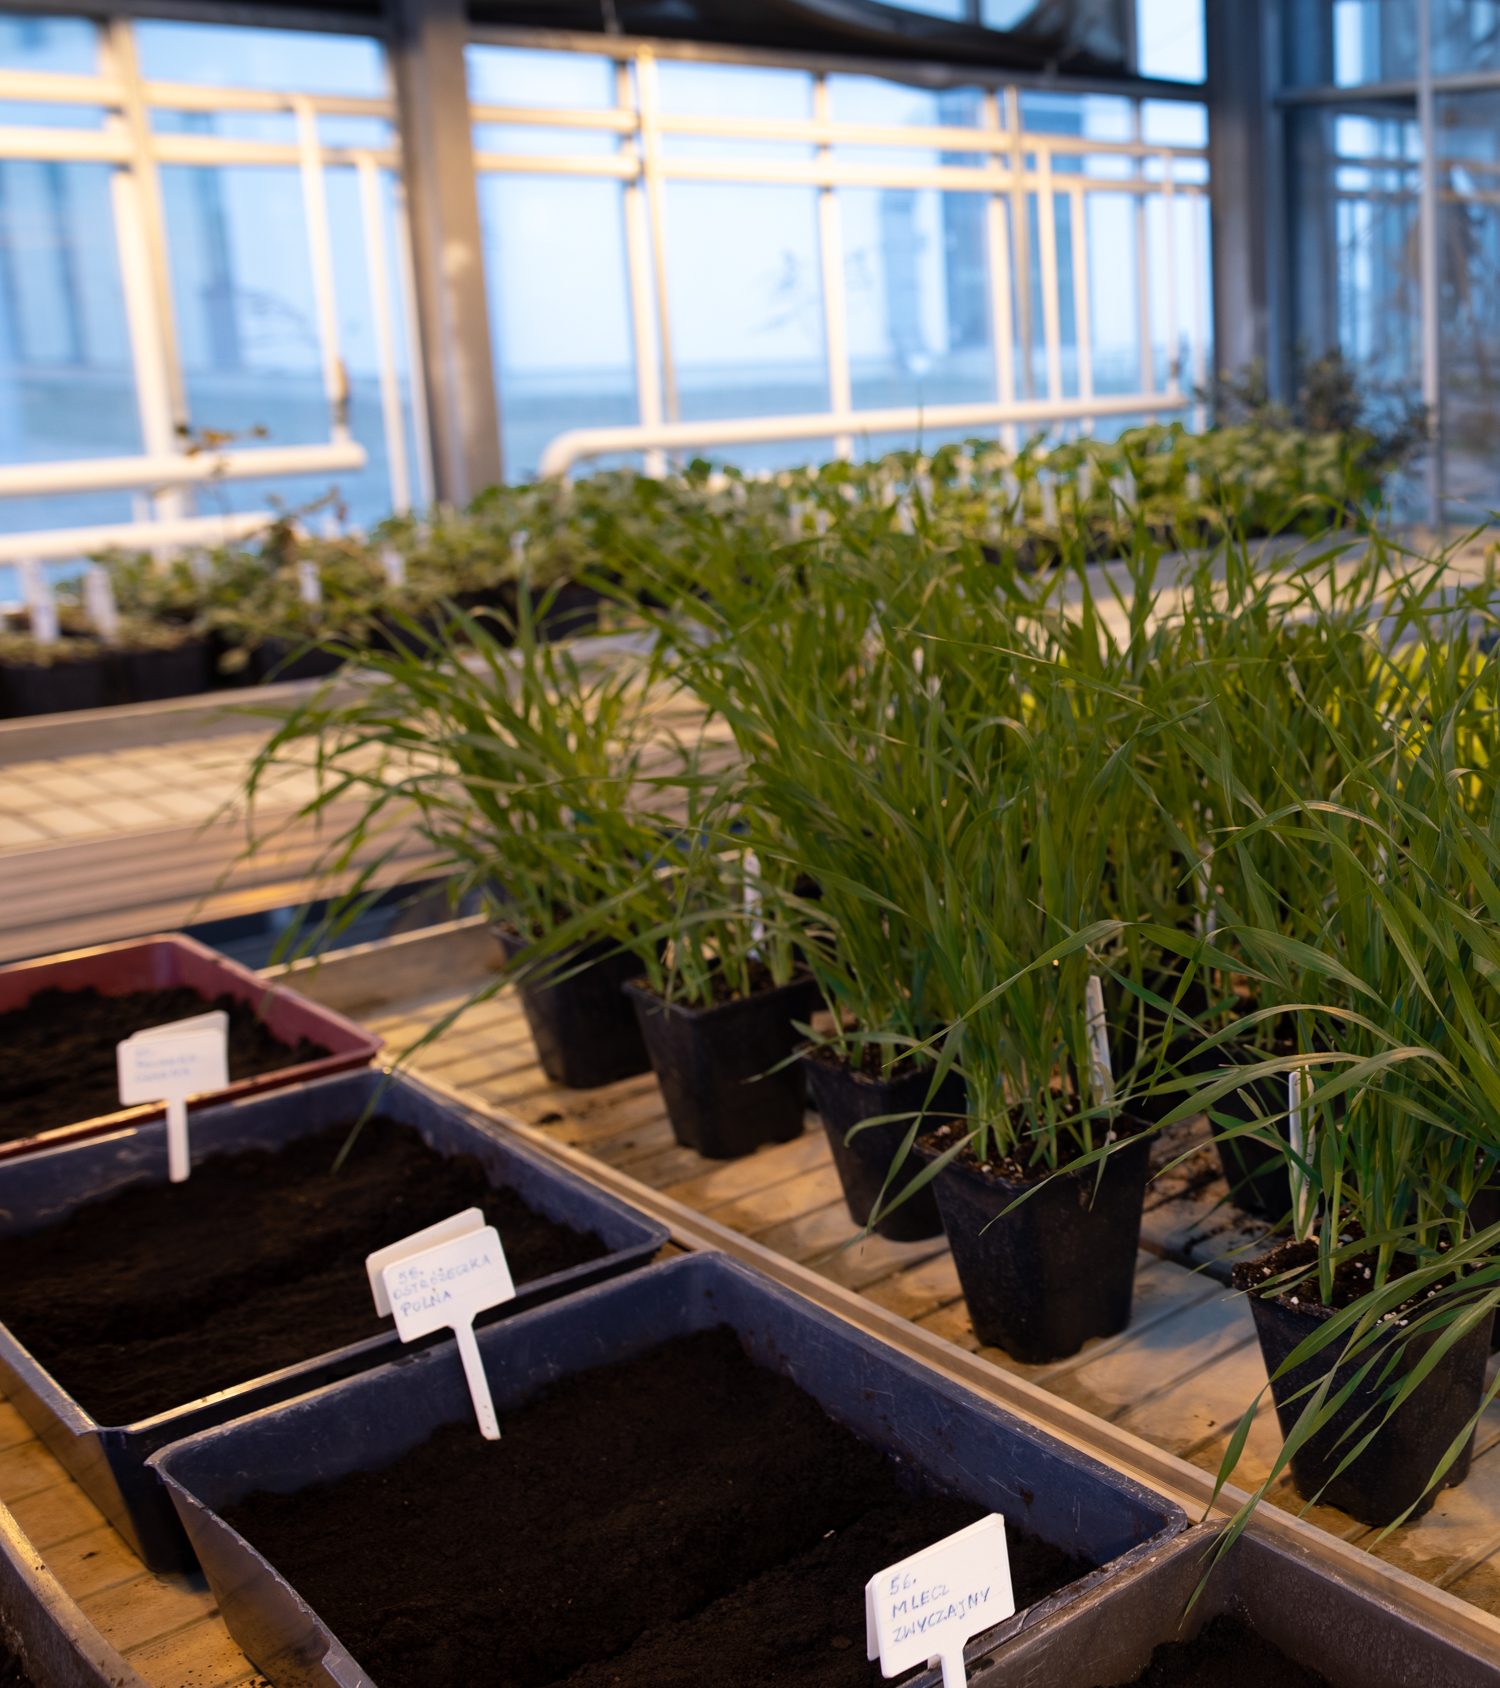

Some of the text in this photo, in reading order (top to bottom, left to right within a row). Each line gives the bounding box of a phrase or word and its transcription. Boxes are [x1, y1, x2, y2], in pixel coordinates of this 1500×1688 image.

[400, 1290, 453, 1317] POLNA
[891, 1583, 950, 1619] MLECZ
[892, 1586, 991, 1643] ZWYCZAJNY
